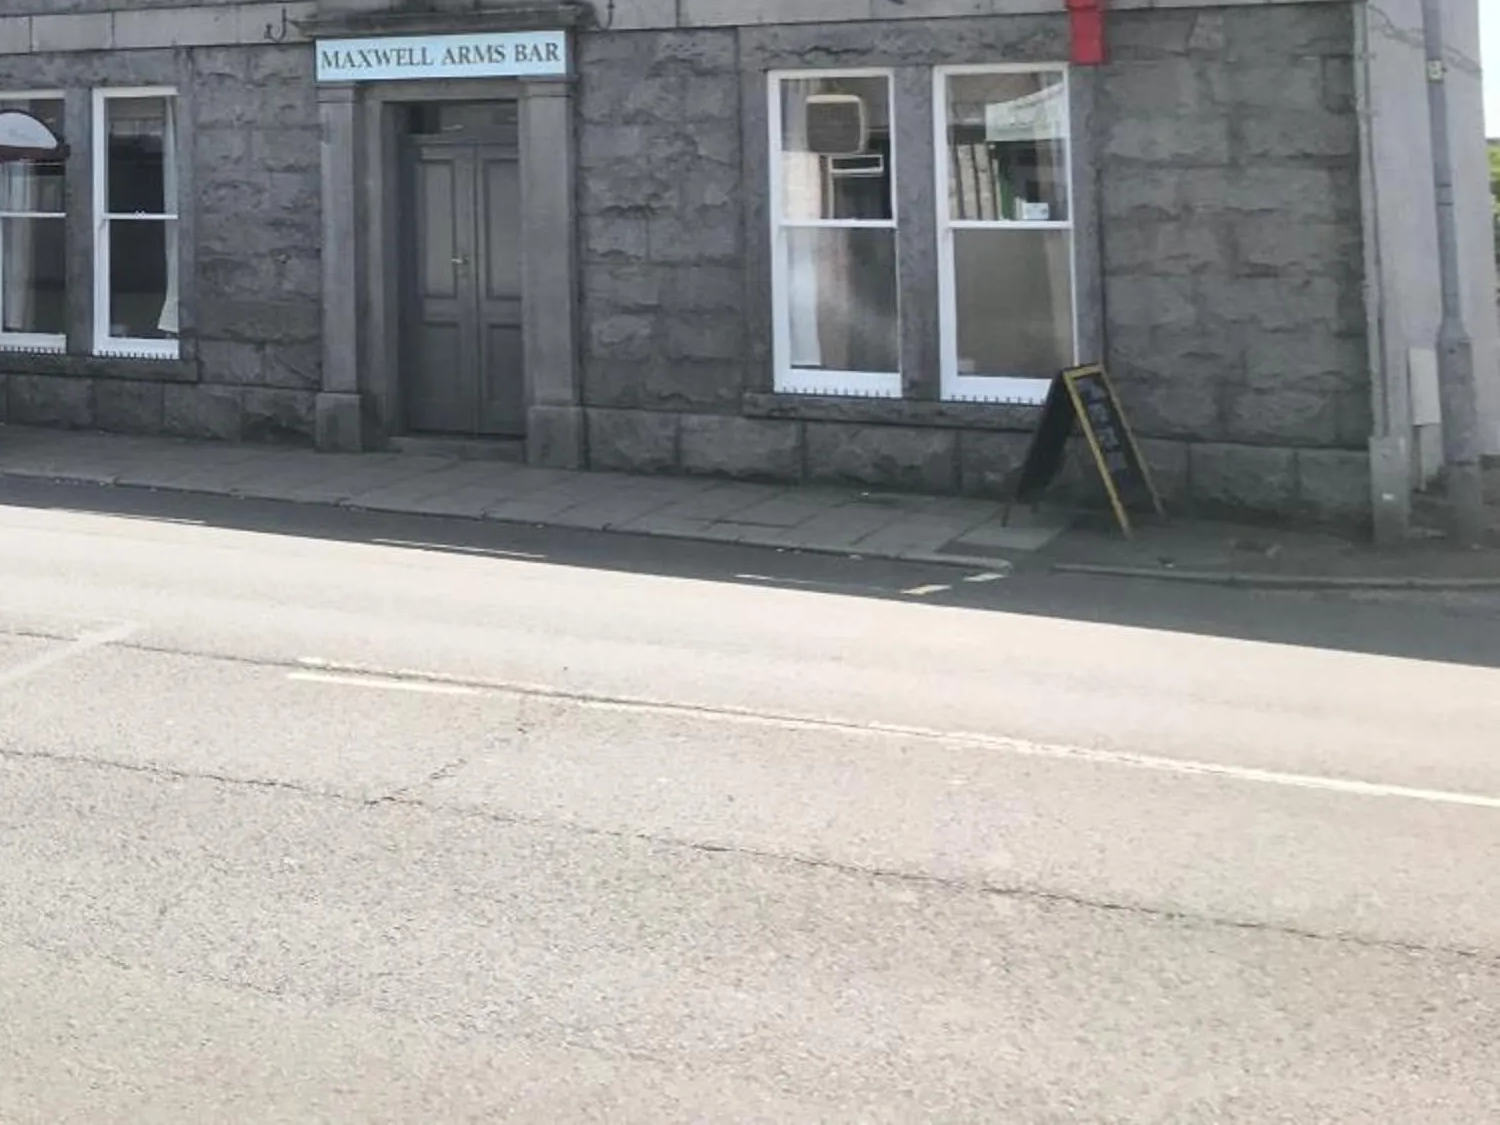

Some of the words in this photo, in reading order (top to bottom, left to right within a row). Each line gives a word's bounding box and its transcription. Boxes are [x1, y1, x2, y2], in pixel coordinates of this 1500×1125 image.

[321, 47, 433, 70] MAXWELL
[441, 44, 506, 65] ARMS
[514, 42, 561, 63] BAR
